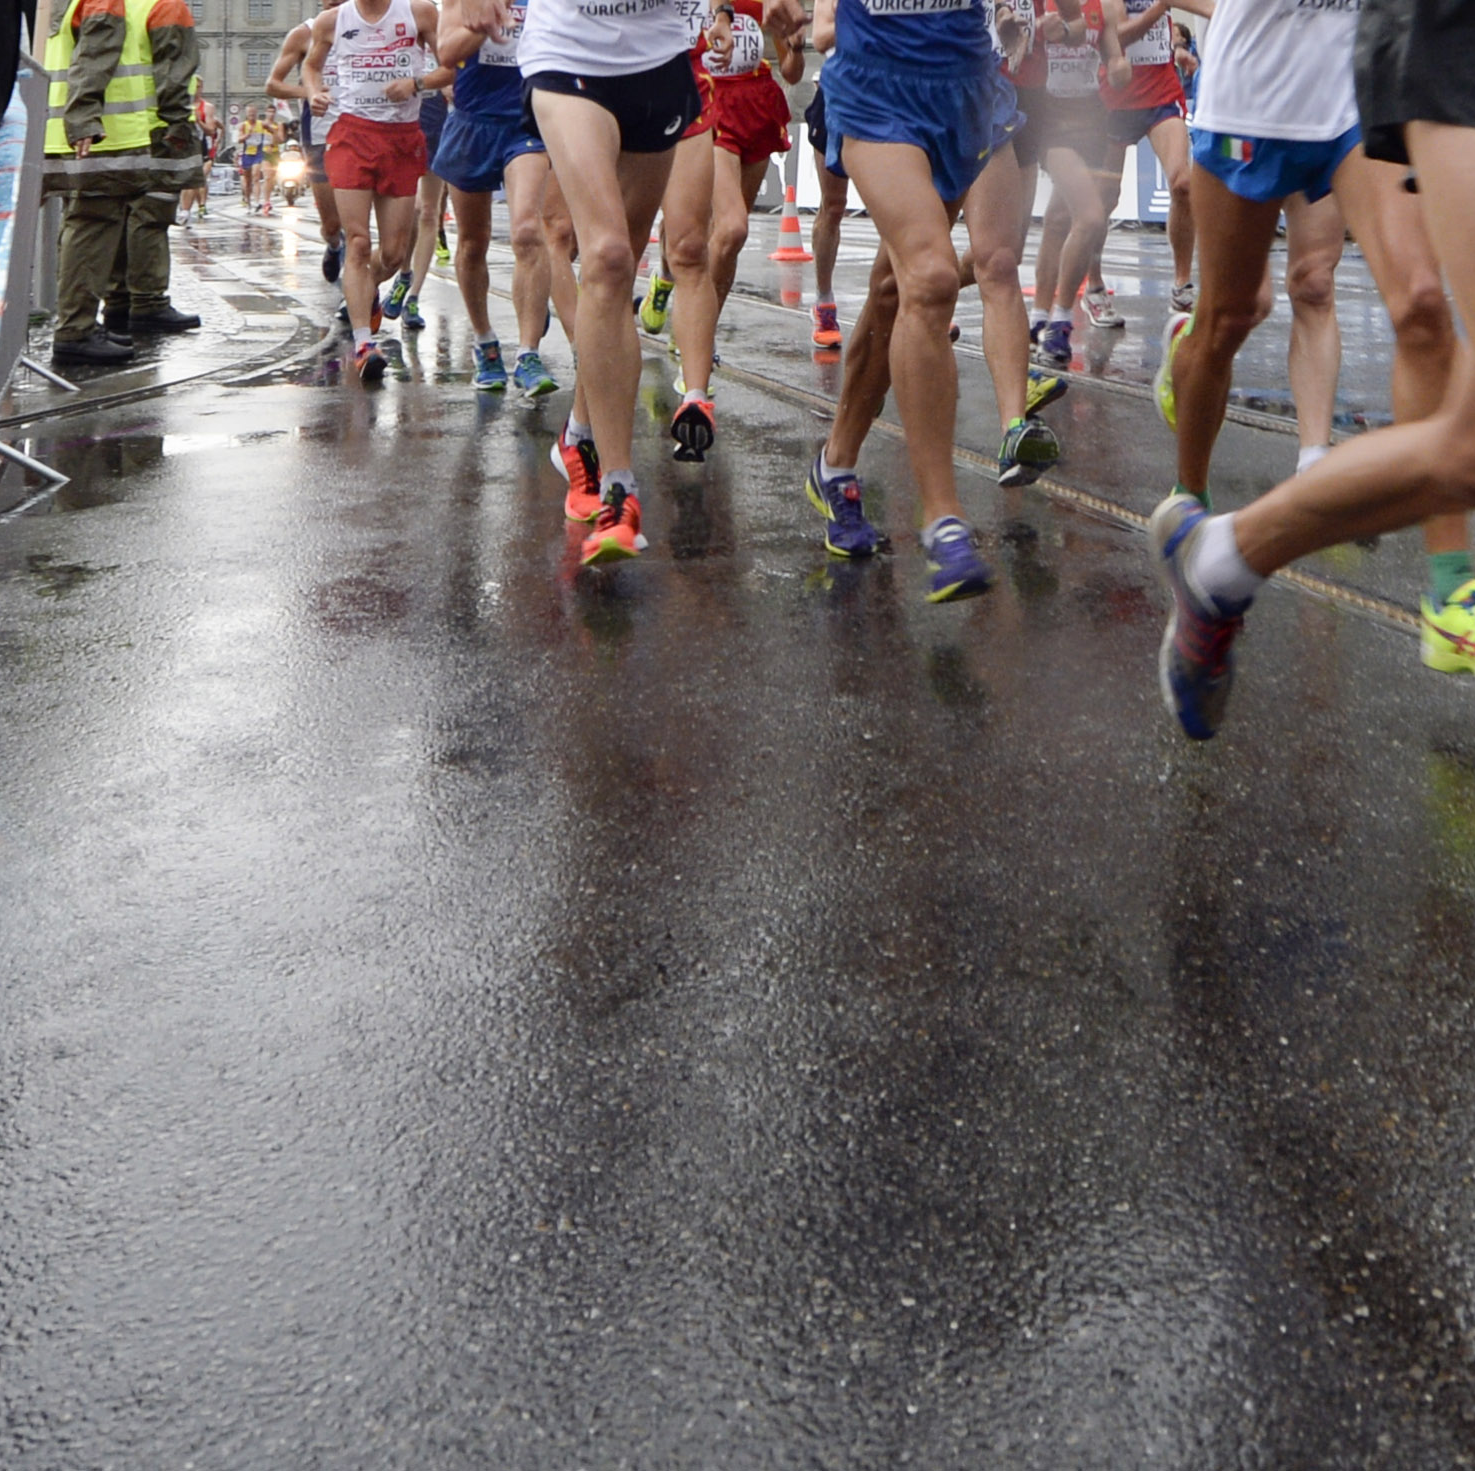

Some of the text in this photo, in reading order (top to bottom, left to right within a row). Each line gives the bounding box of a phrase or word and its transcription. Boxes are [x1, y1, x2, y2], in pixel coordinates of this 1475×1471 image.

[686, 16, 705, 31] 17
[741, 48, 759, 61] 18
[352, 55, 395, 68] SPAR
[355, 96, 389, 105] ZÜRICH
